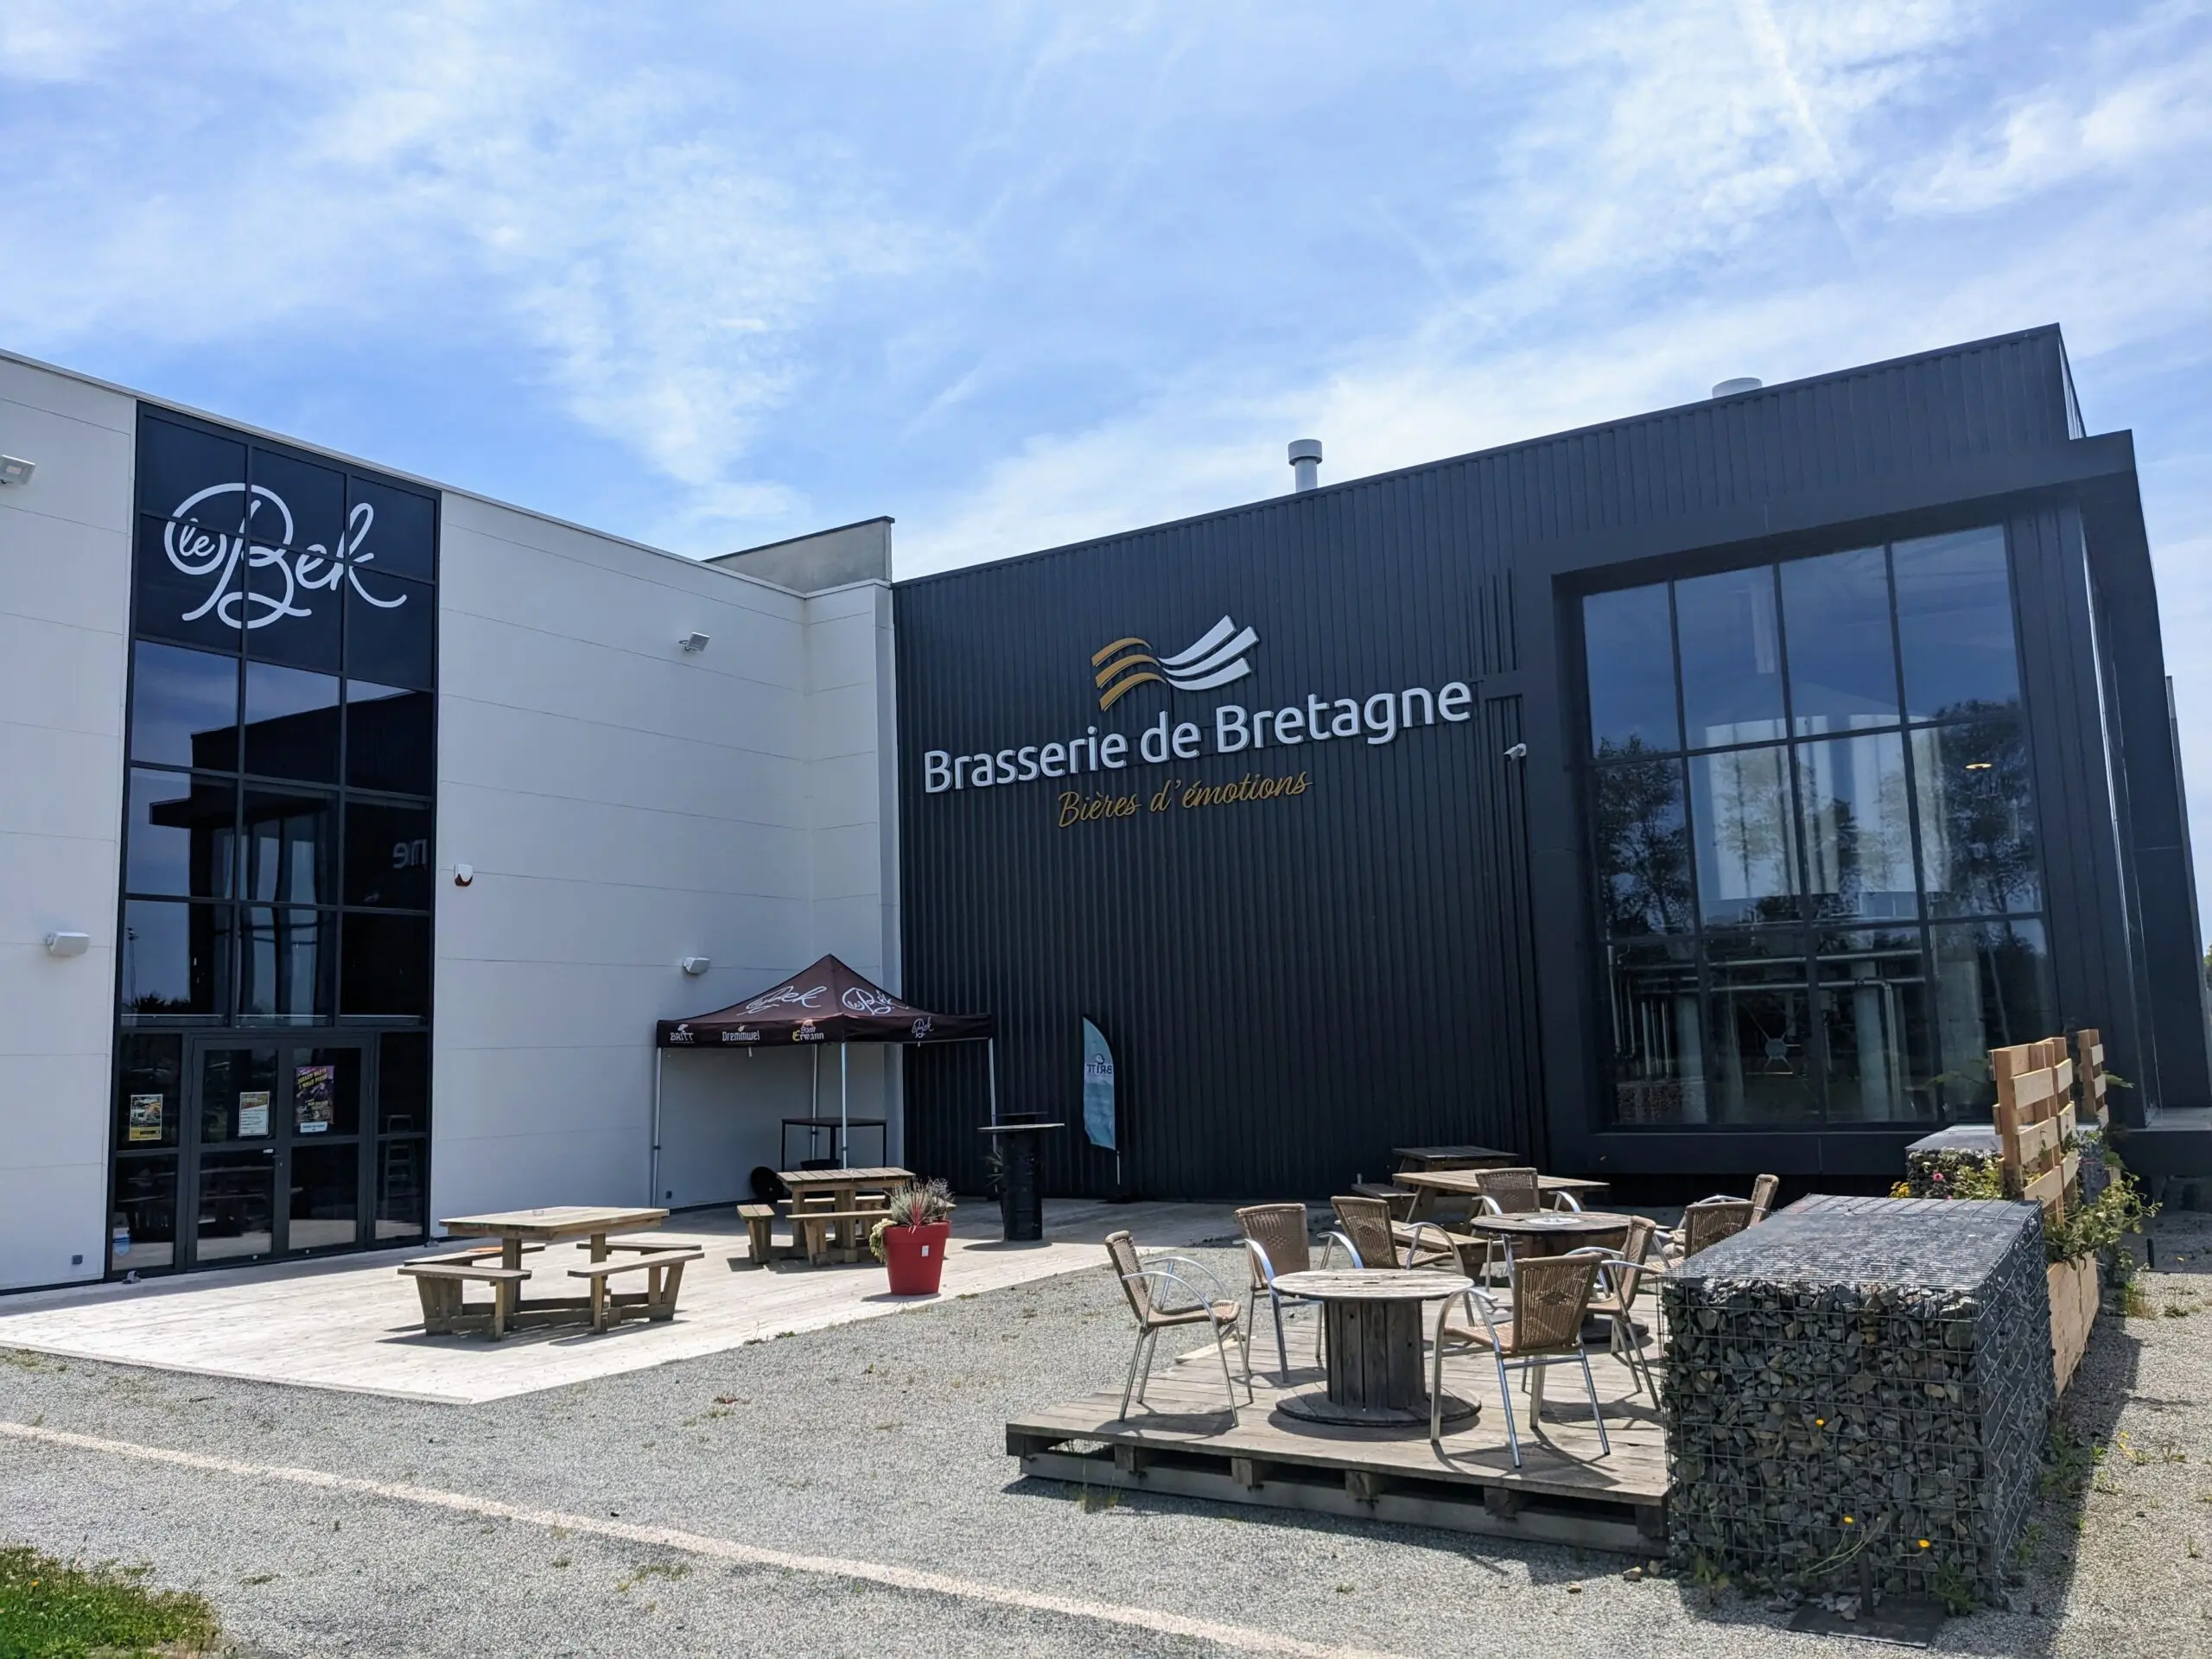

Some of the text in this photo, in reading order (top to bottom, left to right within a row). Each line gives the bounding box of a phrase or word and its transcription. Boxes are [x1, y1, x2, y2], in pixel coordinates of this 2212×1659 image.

[164, 482, 407, 629] Bek
[923, 681, 1472, 793] Brasserie de Bretagne
[1057, 771, 1314, 829] Bières d'émotions
[671, 1031, 694, 1041] BRITT
[722, 1030, 760, 1042] Dremmwel
[792, 1029, 824, 1042] Erwann
